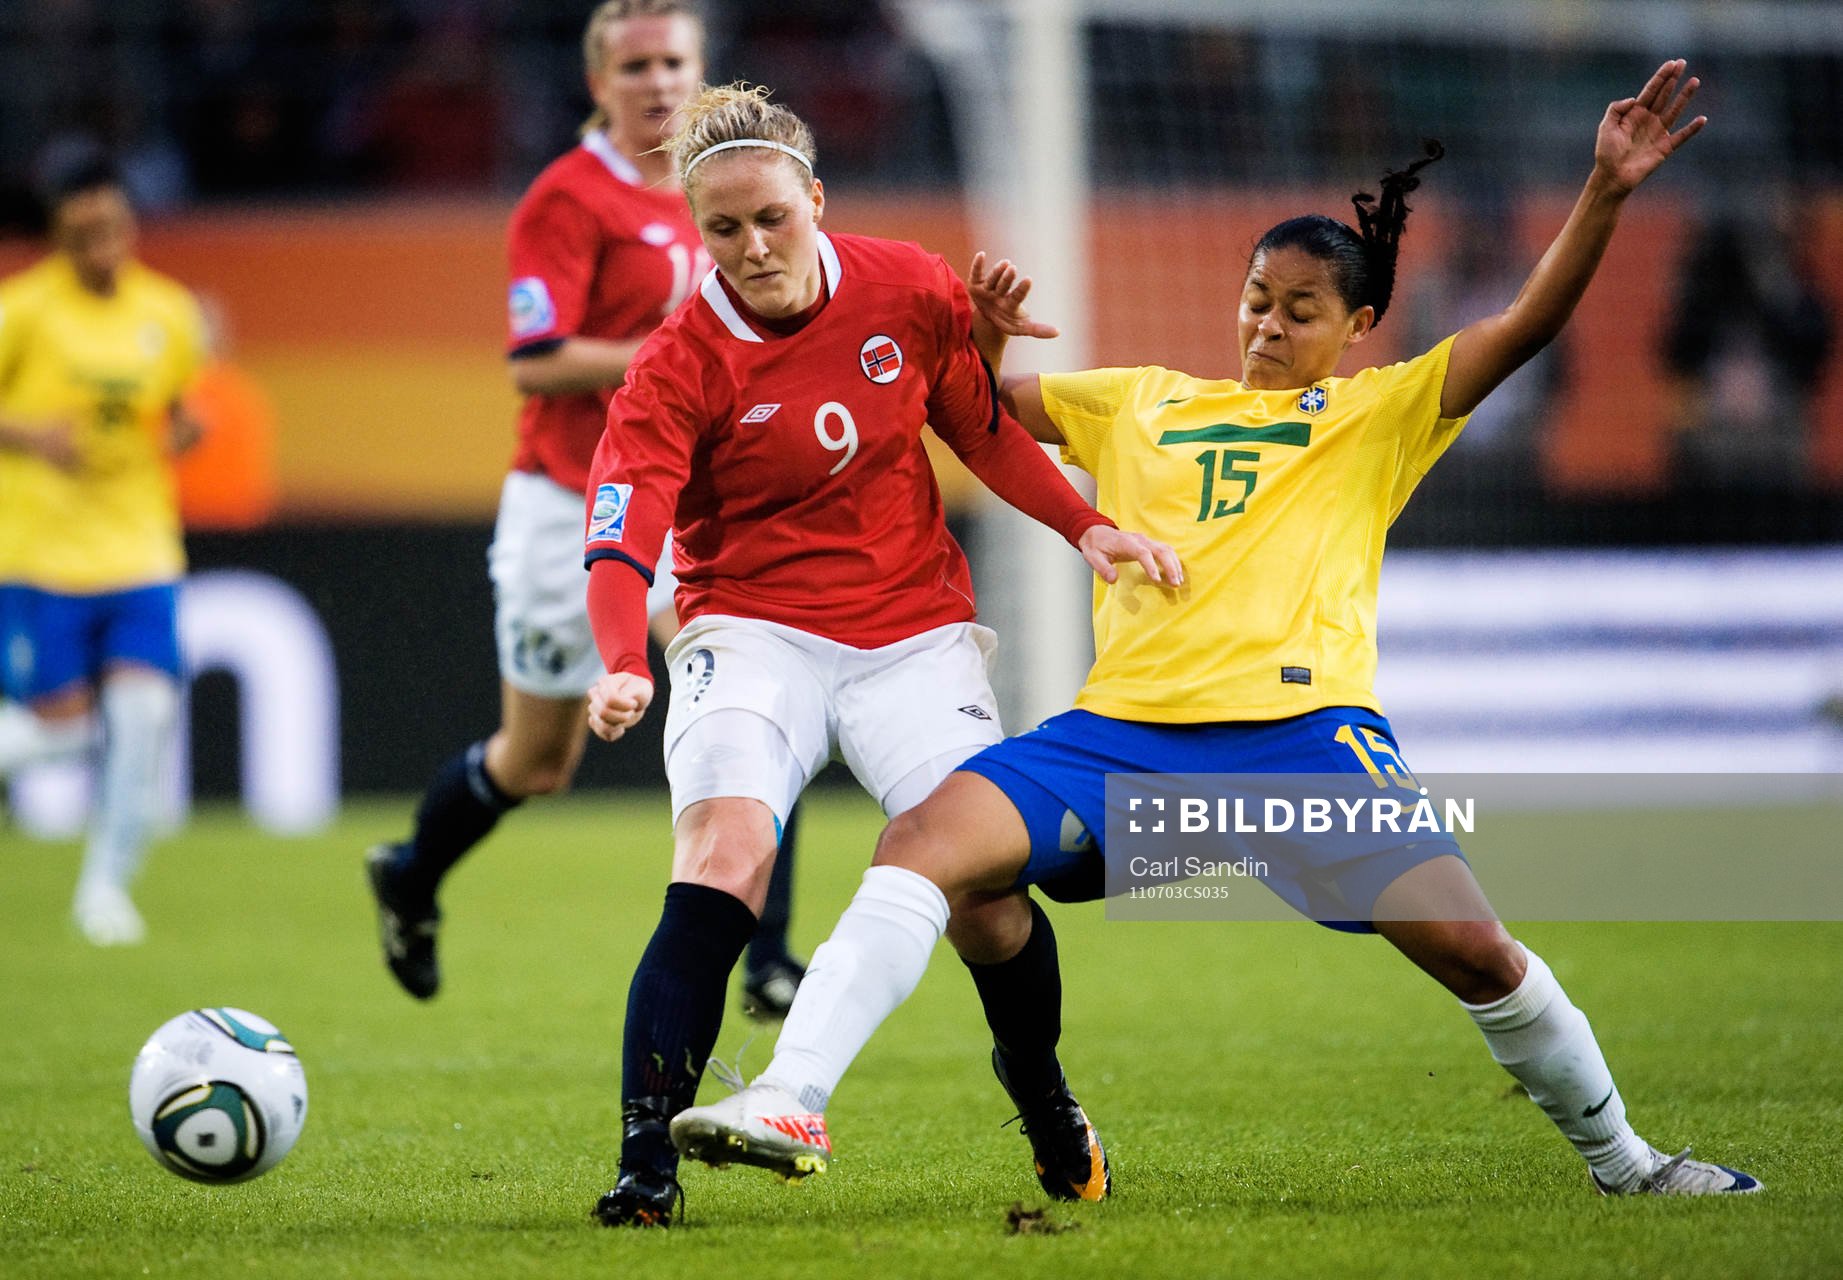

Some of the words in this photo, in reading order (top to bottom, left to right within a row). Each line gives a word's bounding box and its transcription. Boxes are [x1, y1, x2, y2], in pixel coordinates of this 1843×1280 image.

[813, 401, 859, 477] 9
[1194, 449, 1261, 523] 15
[685, 647, 716, 713] 9
[1334, 724, 1421, 794] 15
